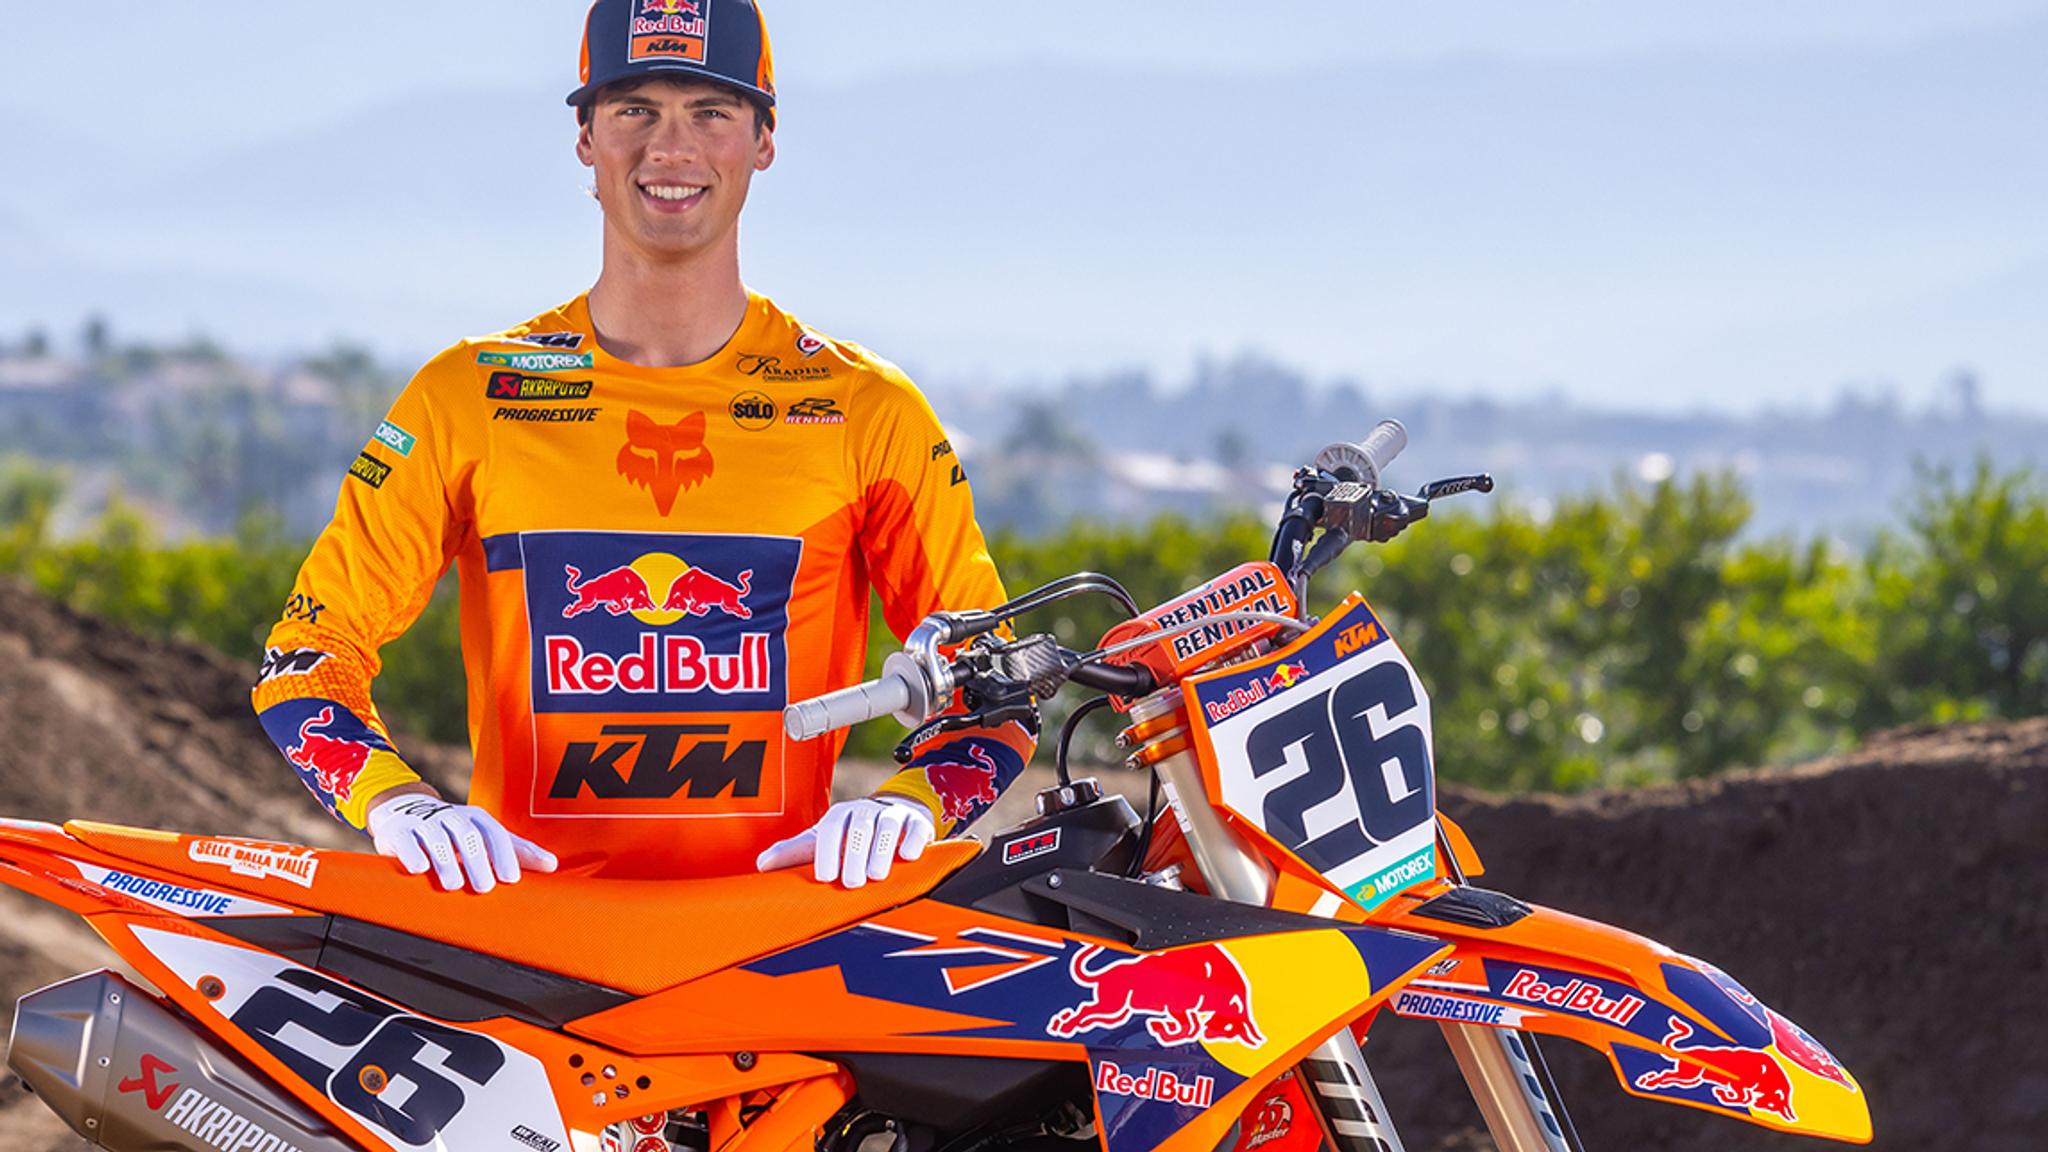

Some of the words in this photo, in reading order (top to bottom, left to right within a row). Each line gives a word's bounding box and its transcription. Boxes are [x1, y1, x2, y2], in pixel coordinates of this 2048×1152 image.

[634, 16, 668, 34] Red
[670, 17, 704, 36] Bull
[646, 38, 688, 53] KTM
[511, 354, 585, 369] MOTOREX
[493, 407, 599, 422] PROGRESSIVE
[733, 402, 774, 419] SOLO
[784, 415, 845, 425] RENTHAL
[1156, 569, 1277, 632] RENTHAL
[1334, 620, 1379, 659] KTM
[545, 632, 658, 693] Red
[664, 632, 770, 693] Bull
[1207, 690, 1237, 722] Red
[1236, 679, 1266, 712] Bull
[548, 724, 768, 798] KTM
[1246, 661, 1433, 875] 26
[196, 841, 232, 858] SELLE
[234, 848, 272, 867] DALLA
[276, 857, 312, 880] VALLE
[1374, 850, 1433, 896] MOTOREX
[100, 871, 232, 915] PROGRESSIVE
[1396, 992, 1505, 1024] PROGRESSIVE
[1503, 969, 1570, 1006] Red
[1567, 985, 1645, 1026] Bull
[229, 968, 506, 1147] 26
[1097, 1061, 1155, 1099] Red
[1154, 1070, 1214, 1108] Bull
